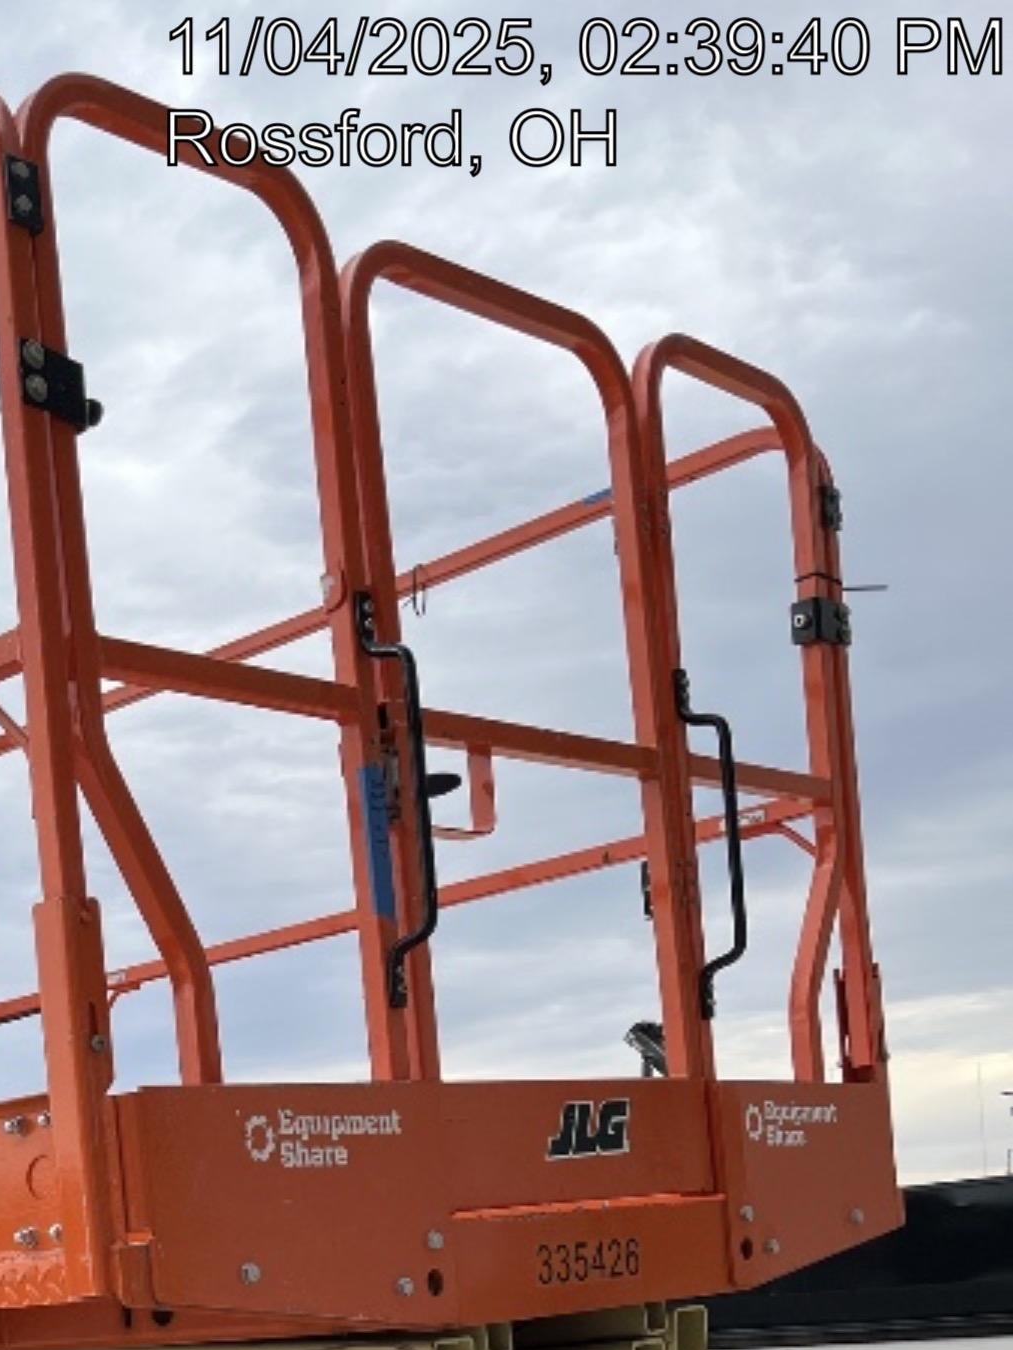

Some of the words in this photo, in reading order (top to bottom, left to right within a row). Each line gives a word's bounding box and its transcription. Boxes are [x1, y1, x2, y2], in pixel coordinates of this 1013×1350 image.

[277, 1109, 402, 1141] Equipment
[545, 1098, 631, 1161] JLG
[280, 1140, 349, 1168] Share
[537, 1238, 640, 1285] 335426
